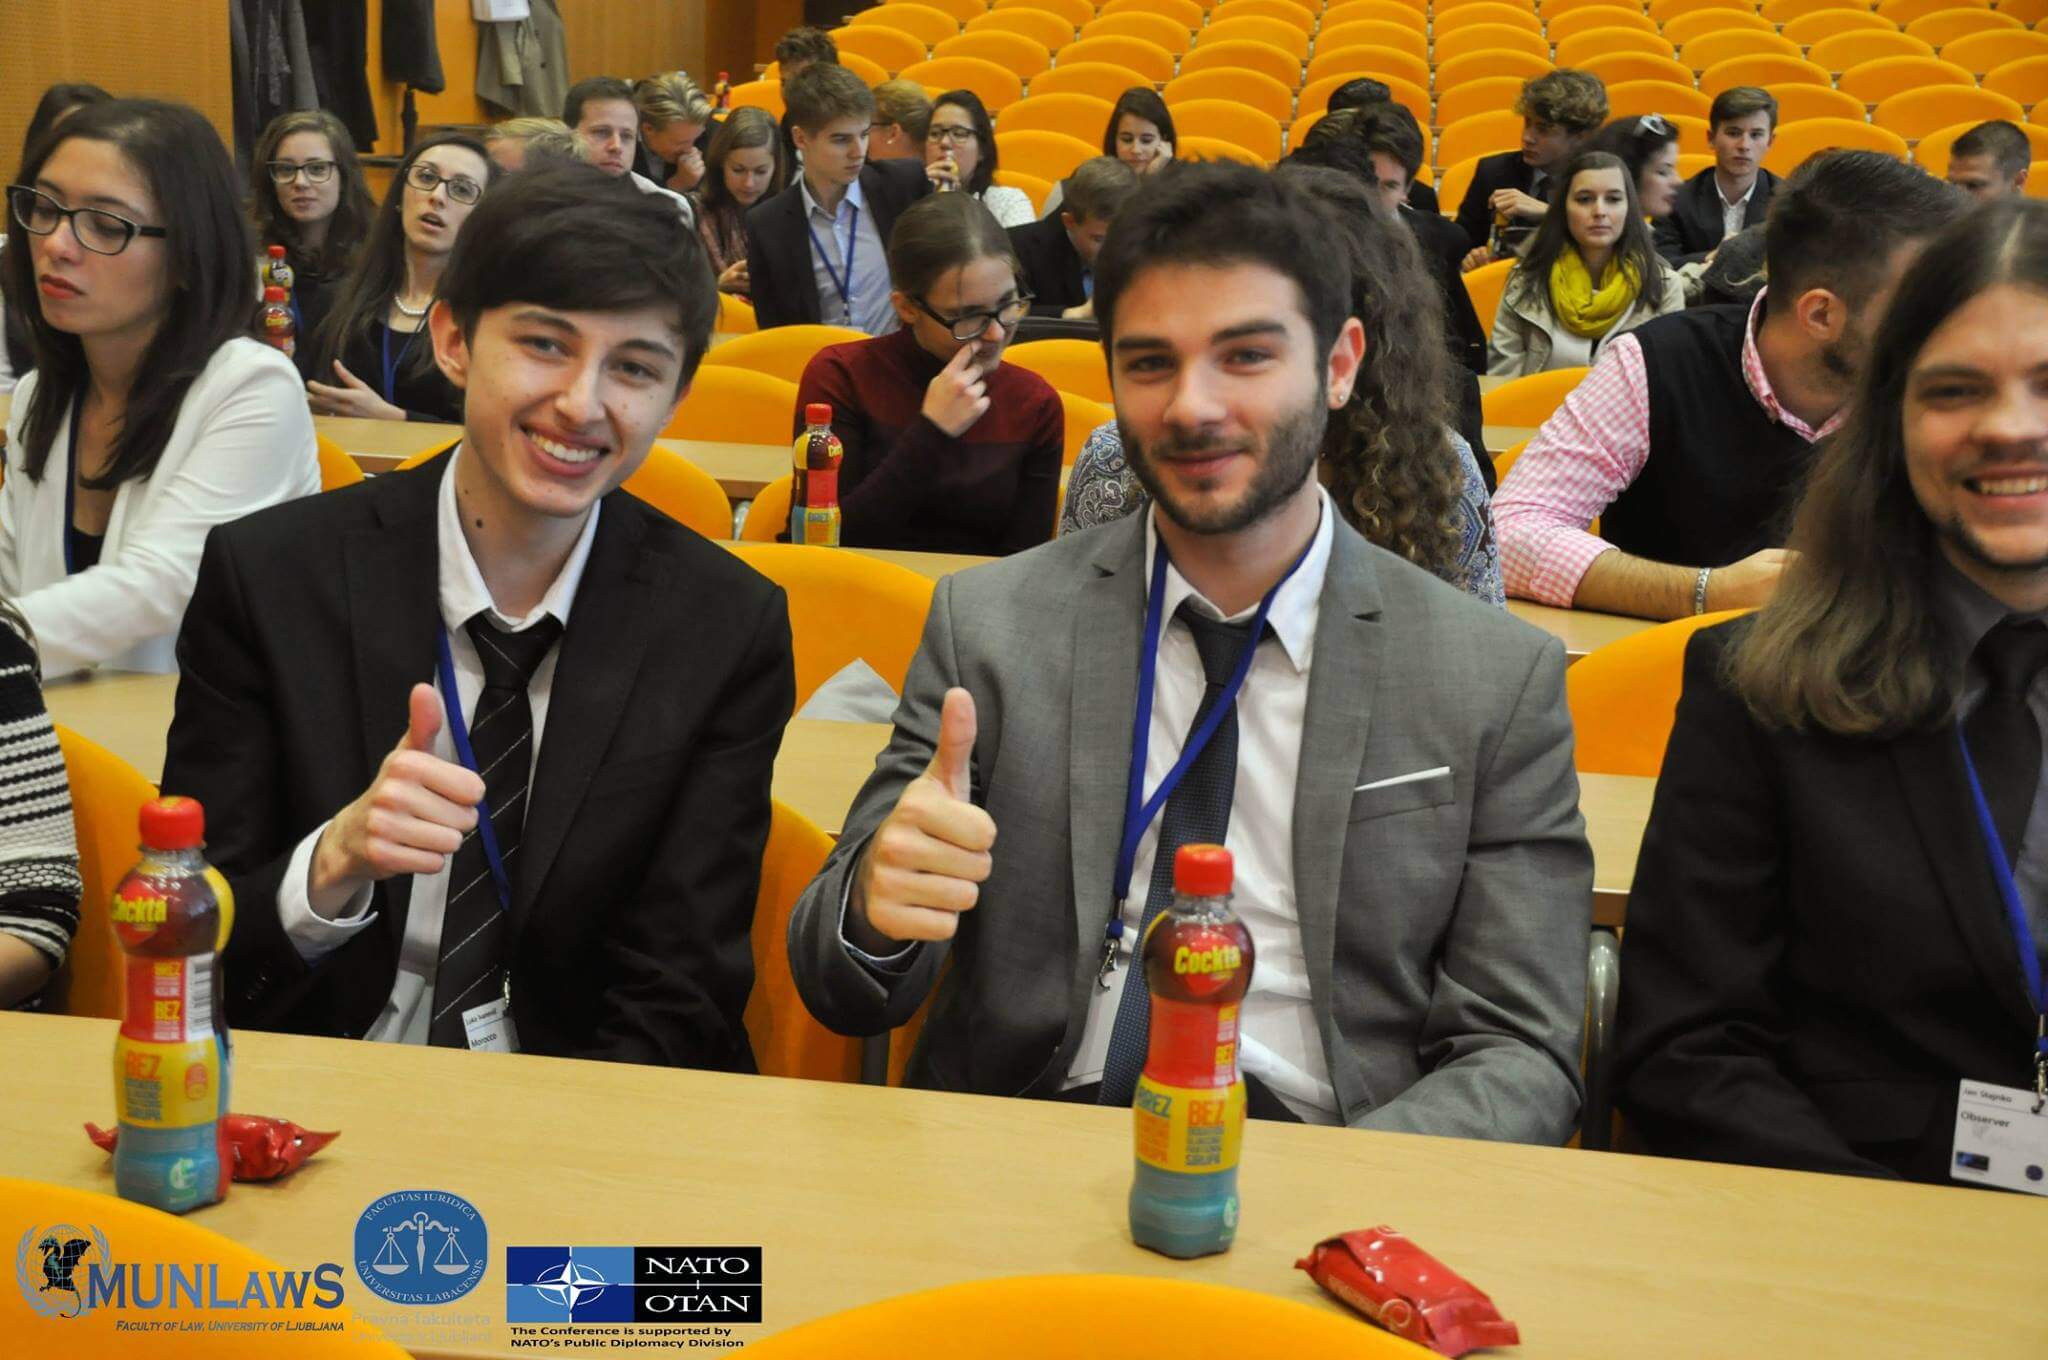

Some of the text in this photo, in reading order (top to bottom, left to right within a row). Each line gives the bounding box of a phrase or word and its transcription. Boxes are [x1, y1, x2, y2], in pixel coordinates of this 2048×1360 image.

[1174, 945, 1242, 974] Cockta
[125, 1050, 162, 1079] BEZ
[1187, 1100, 1225, 1127] BEZ
[1960, 1111, 2011, 1128] Observer
